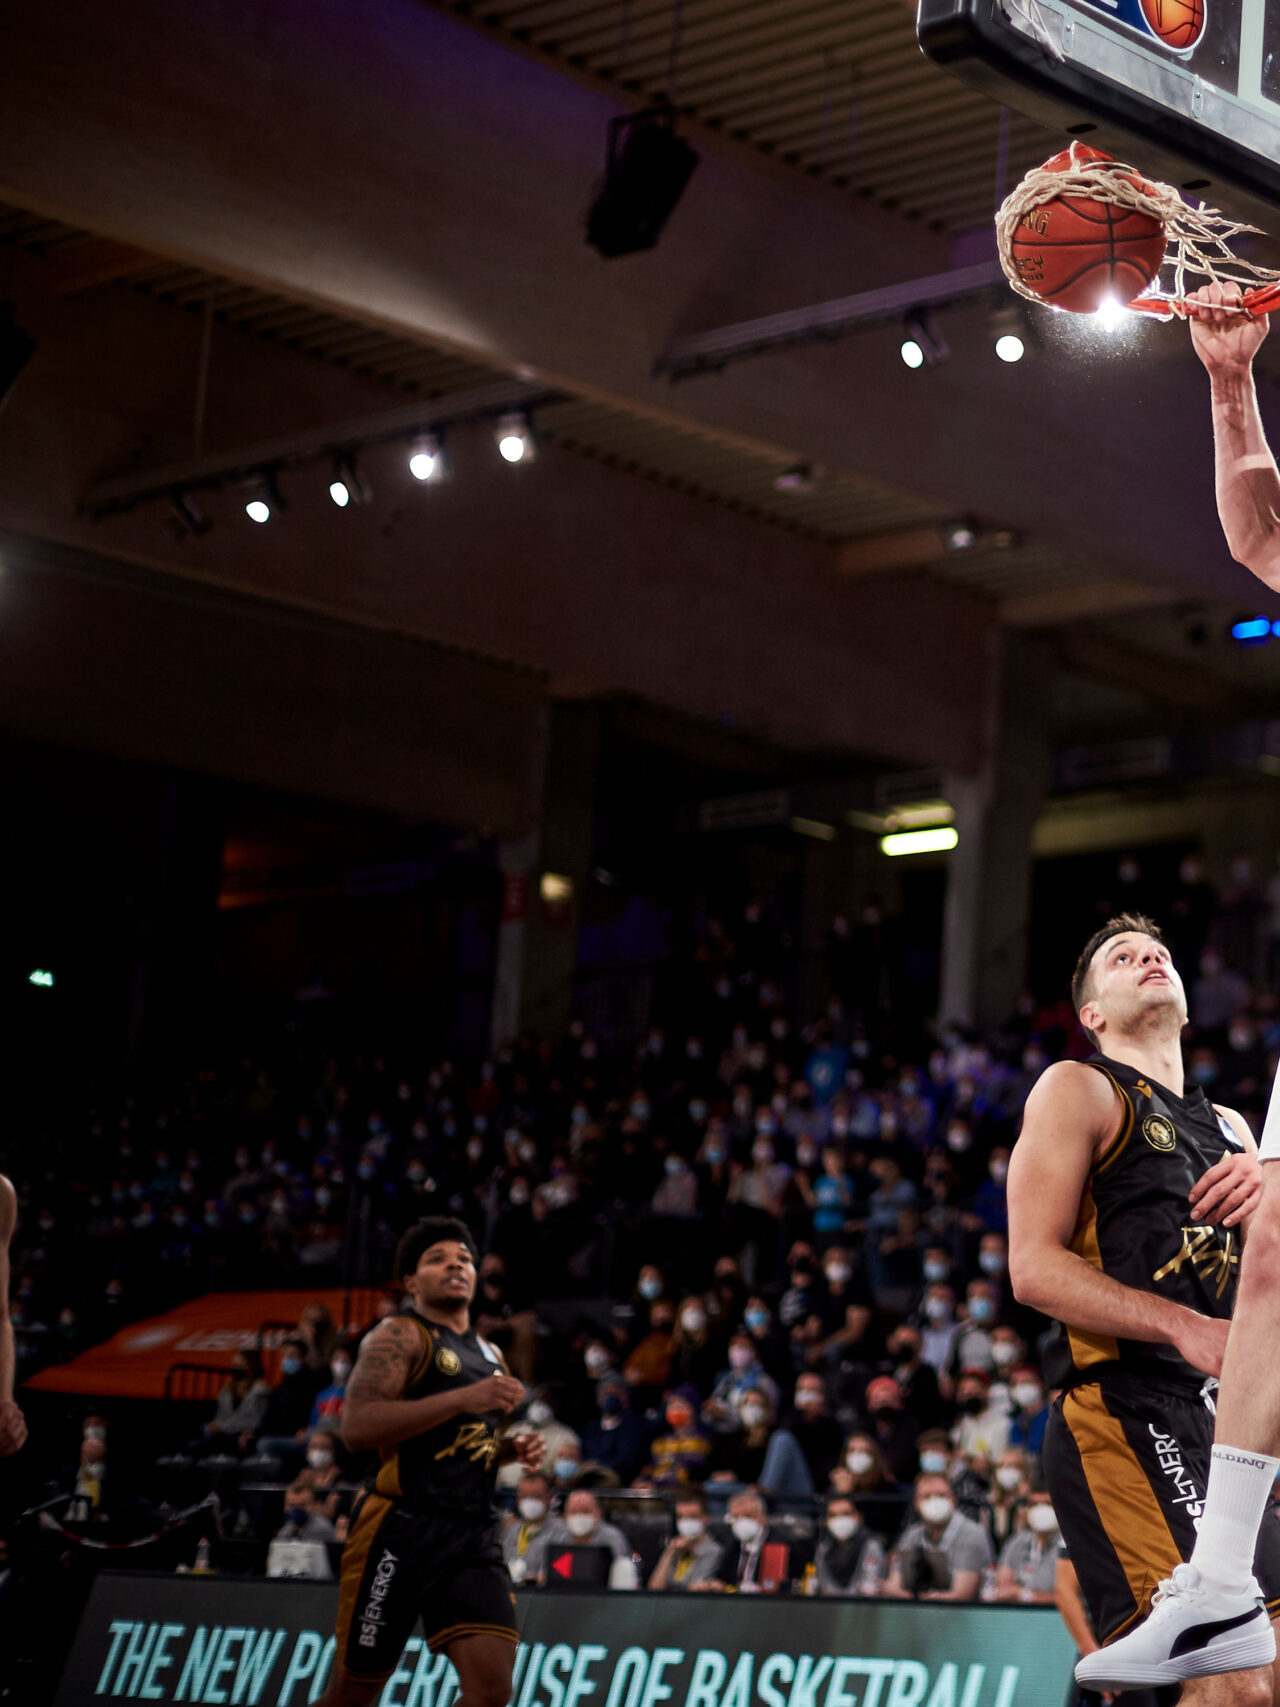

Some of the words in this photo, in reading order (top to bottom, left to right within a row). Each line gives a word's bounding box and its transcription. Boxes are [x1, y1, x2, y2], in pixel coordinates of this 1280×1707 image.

[95, 1619, 186, 1699] THE
[172, 1624, 287, 1706] NEW
[605, 1645, 686, 1707] OF
